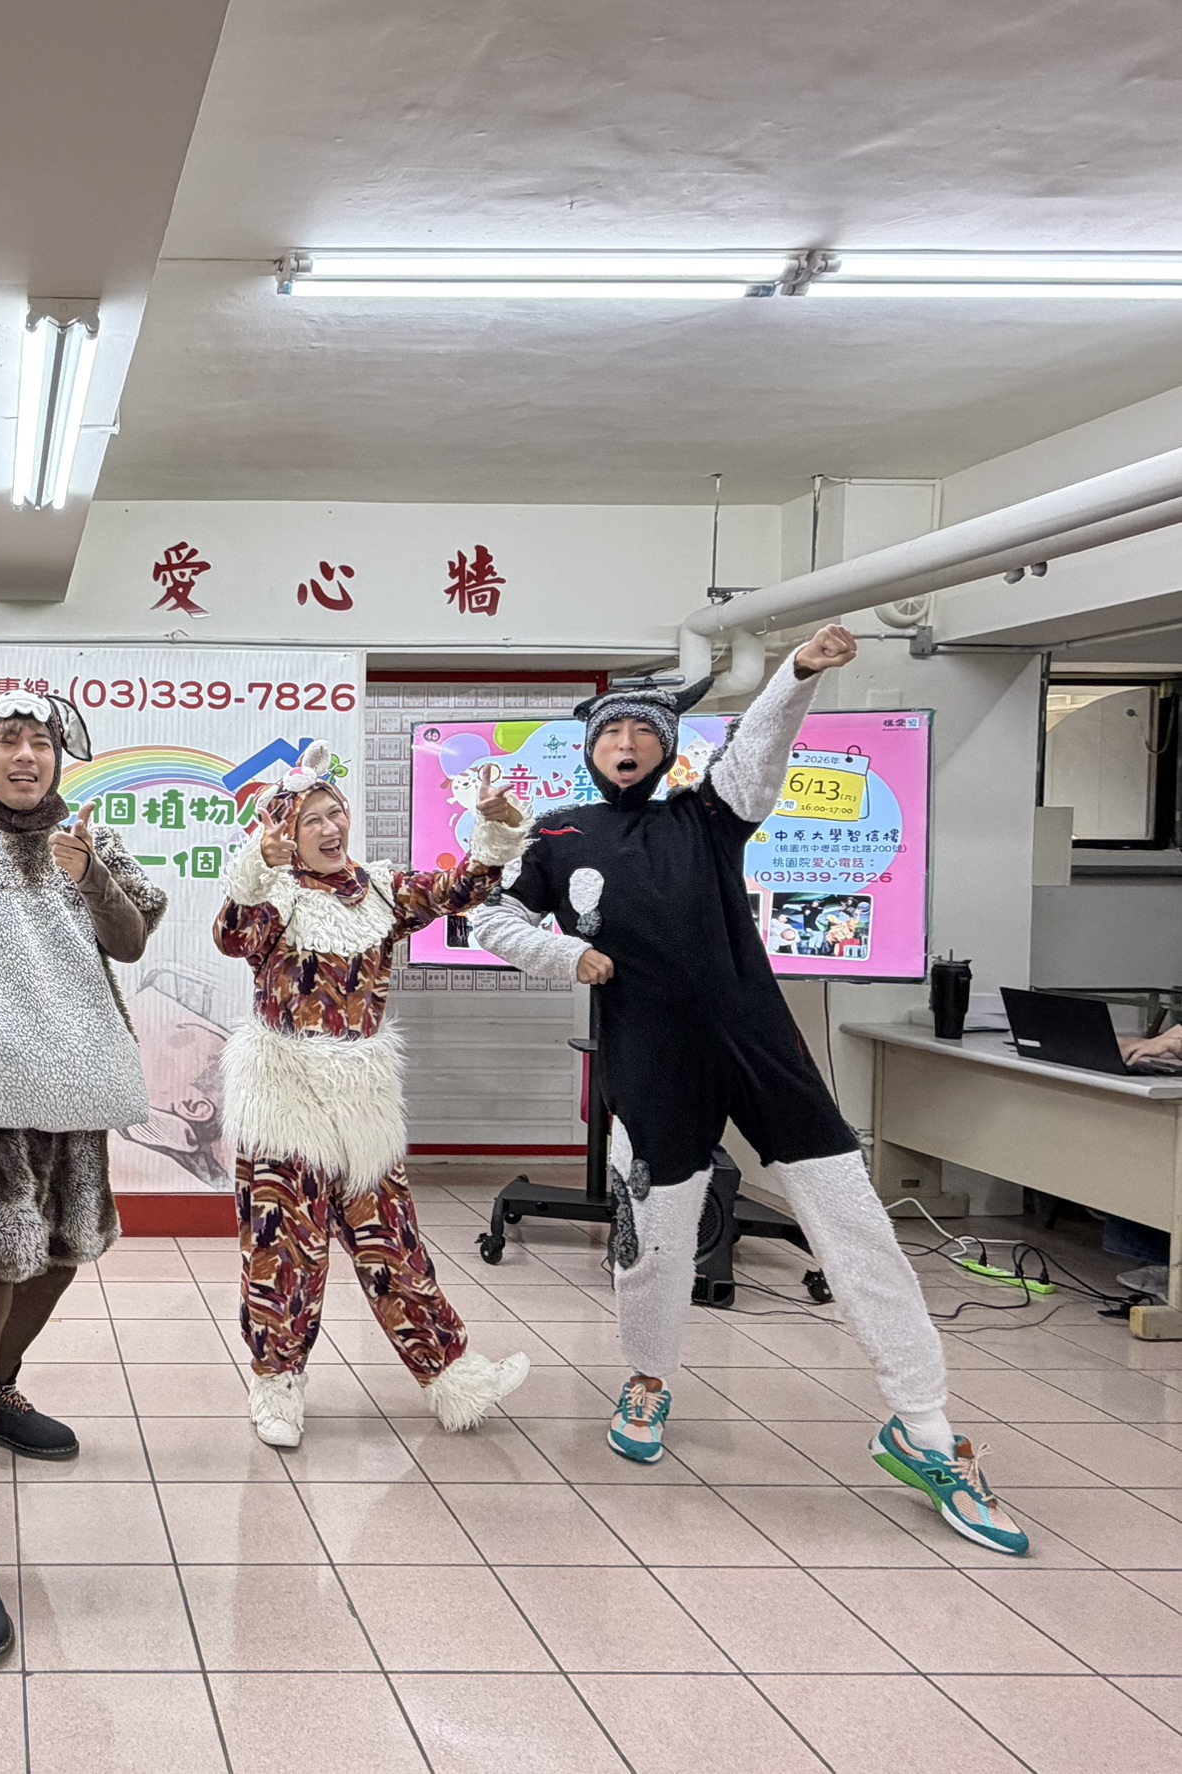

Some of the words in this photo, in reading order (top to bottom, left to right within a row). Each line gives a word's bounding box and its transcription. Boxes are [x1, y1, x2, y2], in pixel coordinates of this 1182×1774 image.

[69, 676, 356, 712] (03)339-7826
[804, 755, 841, 765] 2026年
[801, 804, 853, 815] 16:00-17:00
[774, 828, 900, 843] 中原大學智信樓
[754, 871, 893, 884] (03)339-7826
